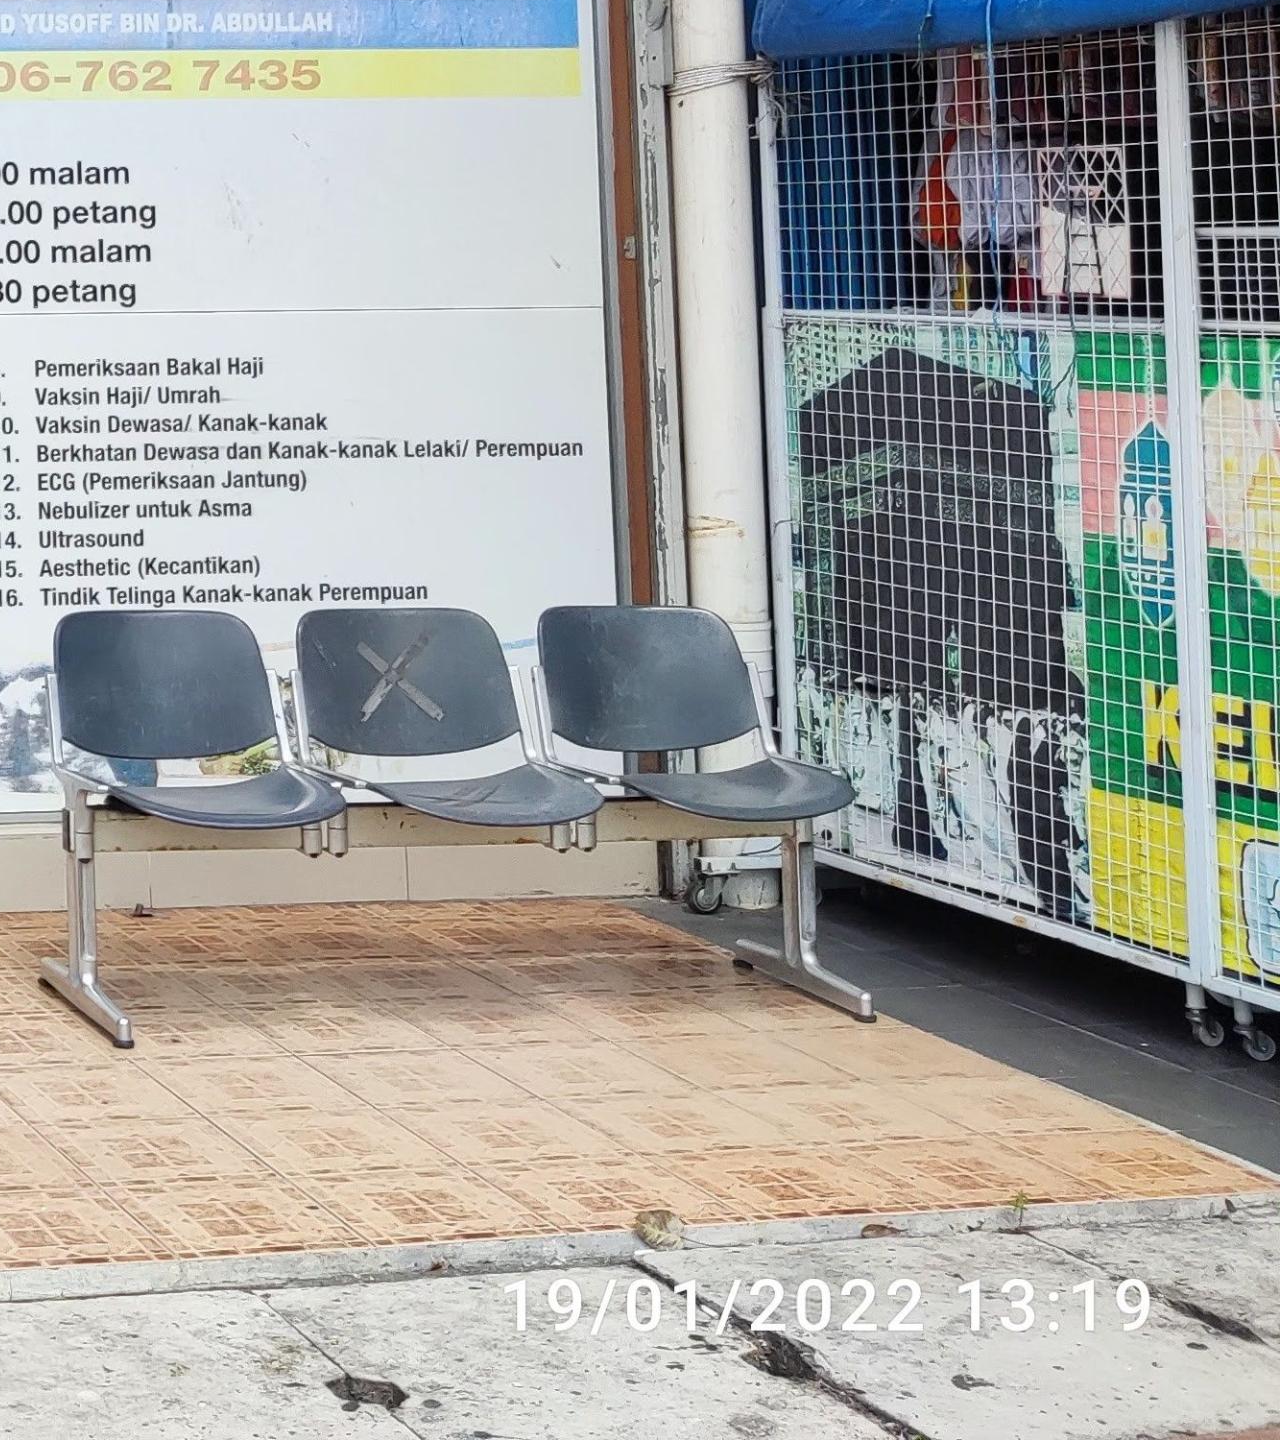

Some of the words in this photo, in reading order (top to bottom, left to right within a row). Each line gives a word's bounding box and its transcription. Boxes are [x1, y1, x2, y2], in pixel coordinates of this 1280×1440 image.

[21, 12, 112, 34] YUSOFF
[120, 12, 160, 33] BIN
[167, 12, 204, 33] DR.
[213, 11, 333, 33] ABDULLAH
[192, 60, 321, 92] 7435
[29, 160, 130, 185] malam
[53, 200, 157, 230] petang
[51, 239, 151, 263] malam
[32, 278, 137, 308] petang
[34, 358, 160, 378] Pemeriksaan
[167, 358, 221, 376] Bakal
[228, 357, 264, 379] Haji
[35, 387, 100, 406] Vaksin
[107, 386, 151, 408] Haji/
[158, 385, 220, 404] Umrah
[35, 415, 100, 434] Vaksin
[108, 414, 192, 433] Dewasa/
[198, 413, 328, 433] Kanak-kanak
[37, 444, 136, 463] Berkhatan
[144, 443, 219, 461] Dewasa
[227, 442, 262, 460] dan
[268, 440, 397, 460] Kanak-kanak
[404, 439, 469, 459] Lelaki/
[475, 438, 583, 461] Perempuan
[37, 472, 75, 491] ECG
[82, 471, 215, 494] (Pemeriksaan
[221, 470, 307, 492] Jantung)
[38, 501, 130, 520] Nebulizer
[136, 500, 192, 518] untuk
[198, 499, 253, 517] Asma
[38, 528, 145, 549] Ultrasound
[40, 557, 130, 577] Aesthetic
[138, 555, 260, 579] (Kecantikan)
[40, 586, 101, 606] Tindik
[106, 585, 176, 609] Telinga
[182, 584, 312, 605] Kanak-kanak
[319, 583, 428, 605] Perempuan
